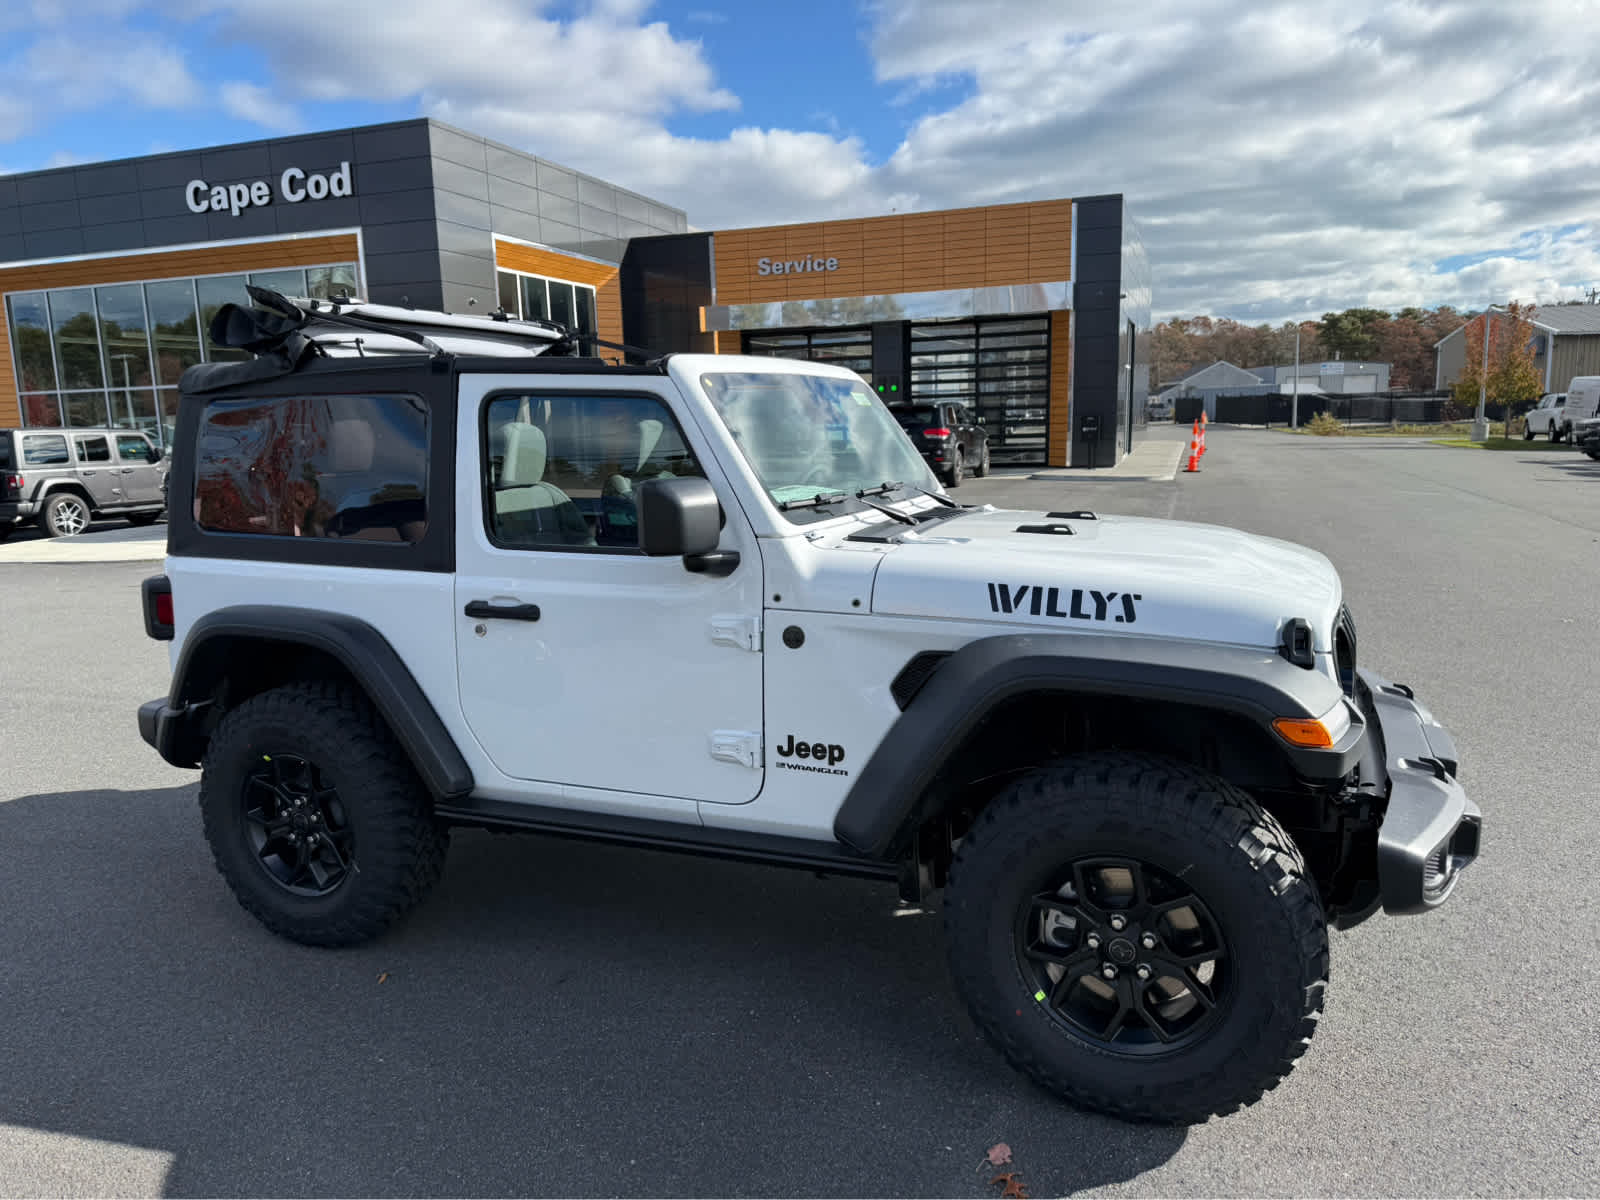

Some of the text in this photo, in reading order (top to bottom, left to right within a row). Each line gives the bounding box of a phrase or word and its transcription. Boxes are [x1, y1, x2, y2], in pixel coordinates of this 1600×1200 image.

[185, 161, 353, 216] Cape Cod
[758, 254, 838, 276] Service
[988, 583, 1142, 623] WILLYS
[776, 735, 845, 766] Jeep
[786, 763, 849, 776] WRANGLER
